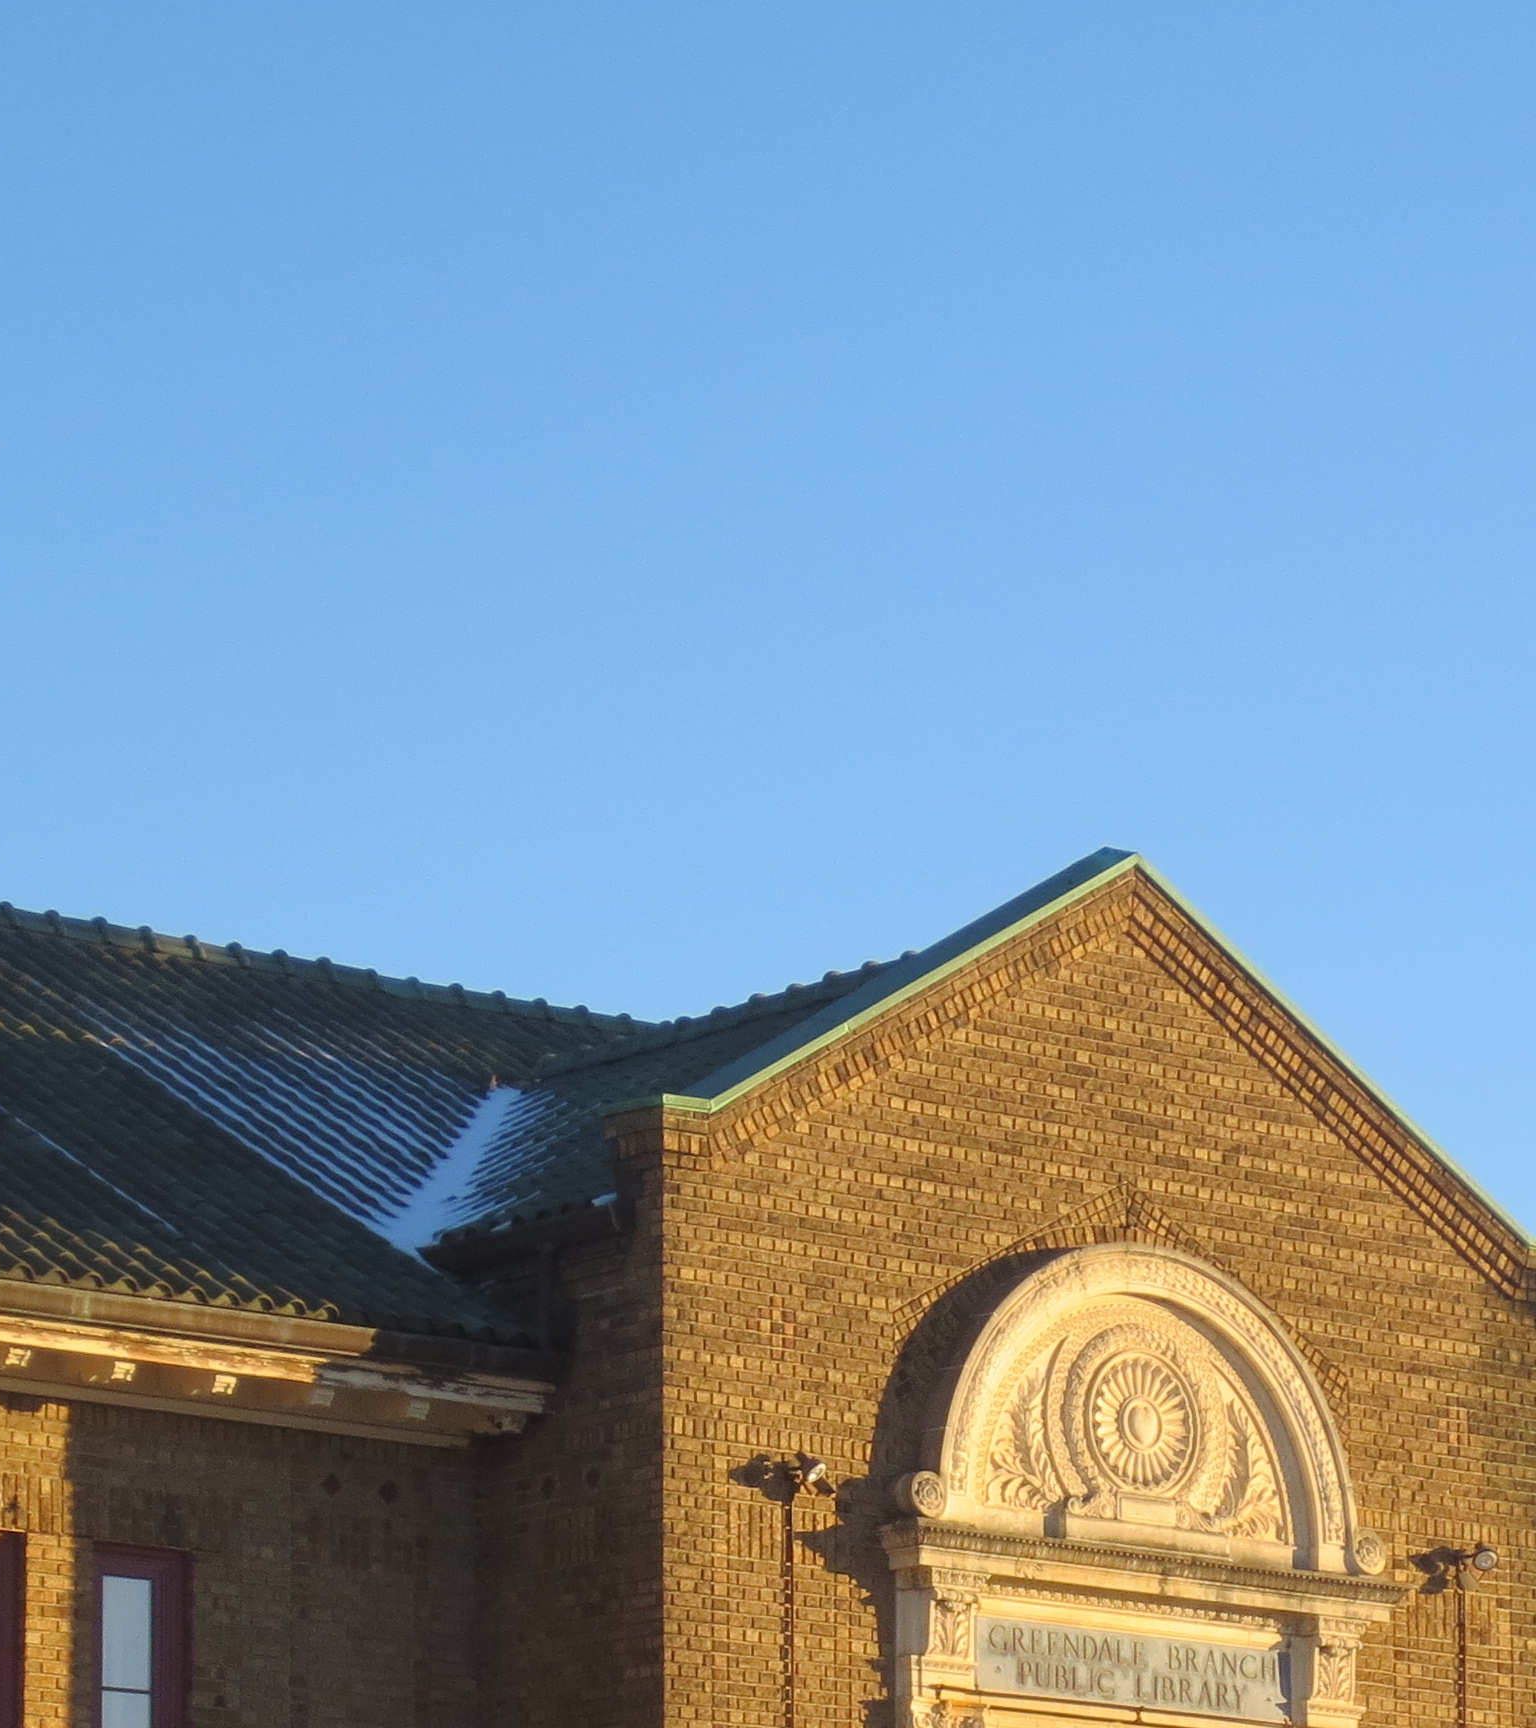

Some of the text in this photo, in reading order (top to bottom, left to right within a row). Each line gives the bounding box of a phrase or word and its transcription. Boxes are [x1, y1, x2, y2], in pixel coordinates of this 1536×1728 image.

[988, 1624, 1277, 1682] GREENDALE BRANCH
[1019, 1661, 1247, 1714] PUBLIC LIBRARY
